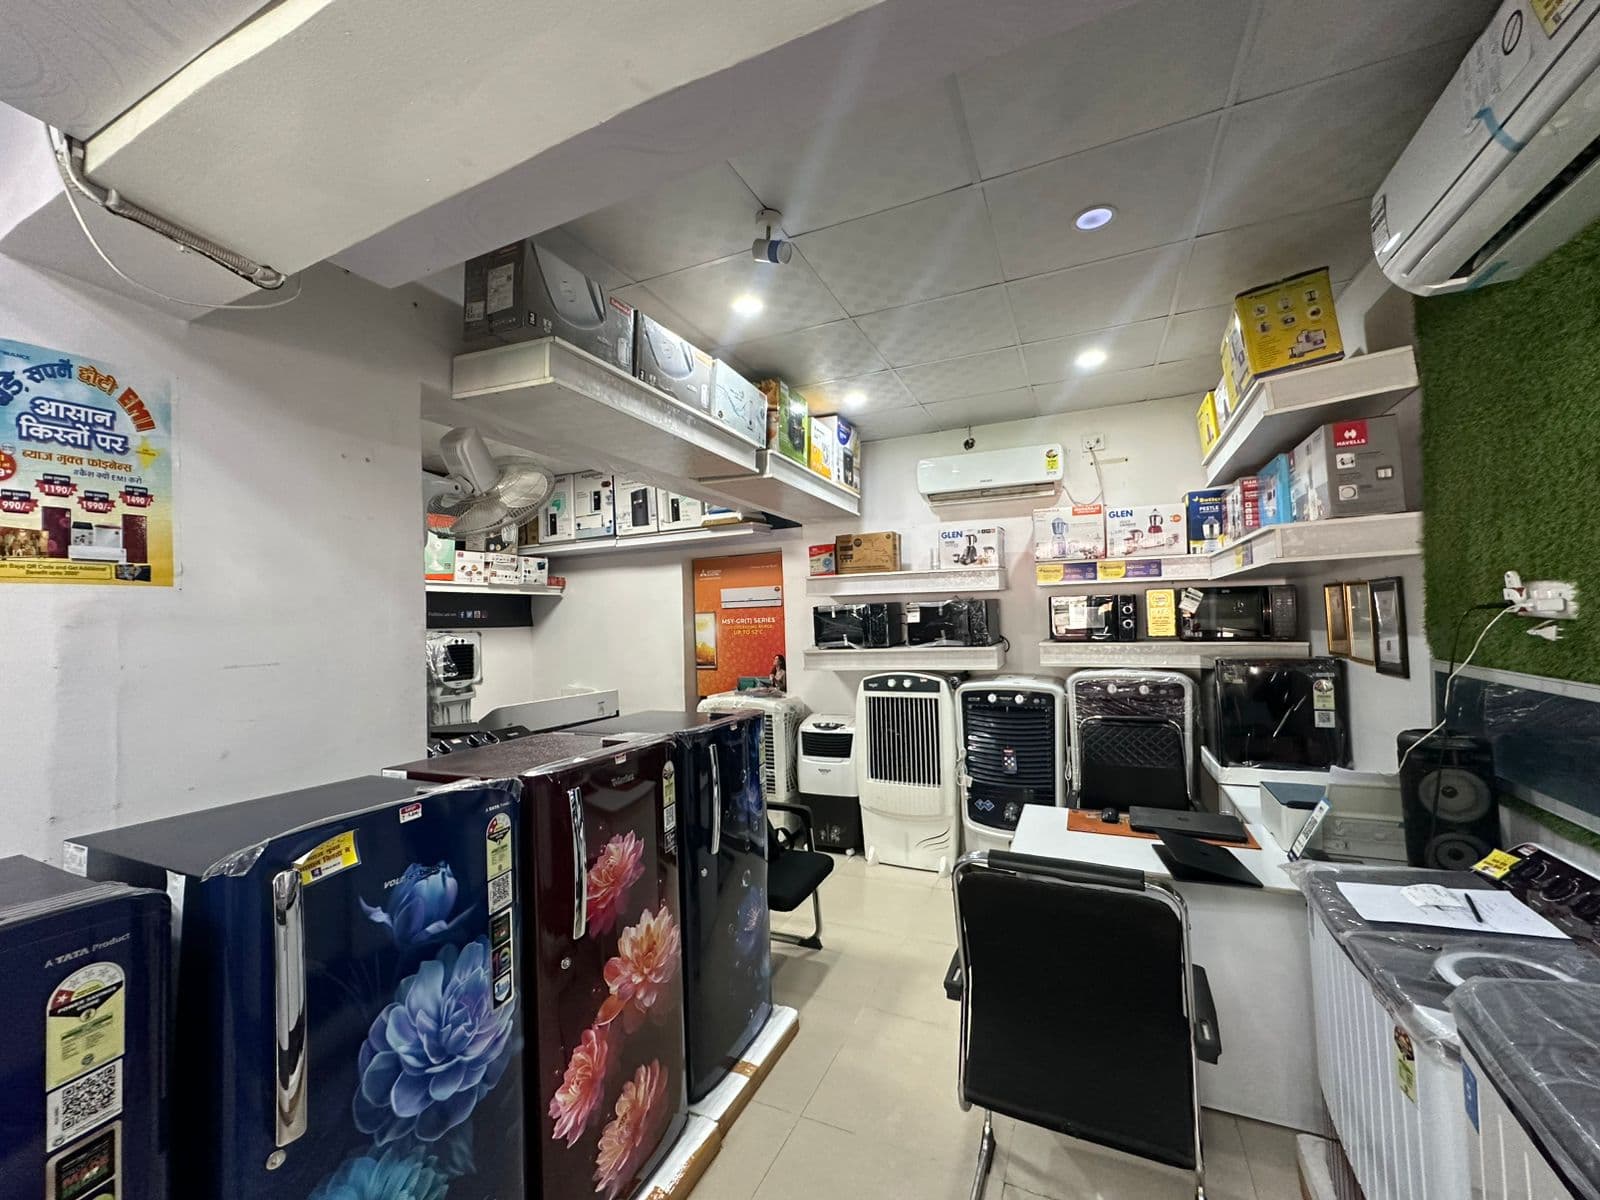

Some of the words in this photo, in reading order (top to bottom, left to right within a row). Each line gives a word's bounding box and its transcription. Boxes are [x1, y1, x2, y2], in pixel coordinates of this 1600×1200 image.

[34, 399, 113, 427] आसान
[116, 387, 156, 433] EMI
[19, 414, 90, 447] किस्तों
[95, 433, 127, 452] पर
[1336, 438, 1366, 447] HAVELLS
[44, 484, 76, 495] 1190/-
[2, 500, 31, 511] 990/-
[1108, 509, 1133, 518] GLEN
[941, 531, 963, 539] GLEN
[45, 960, 54, 969] A
[55, 948, 90, 964] TATA
[92, 933, 130, 952] Product
